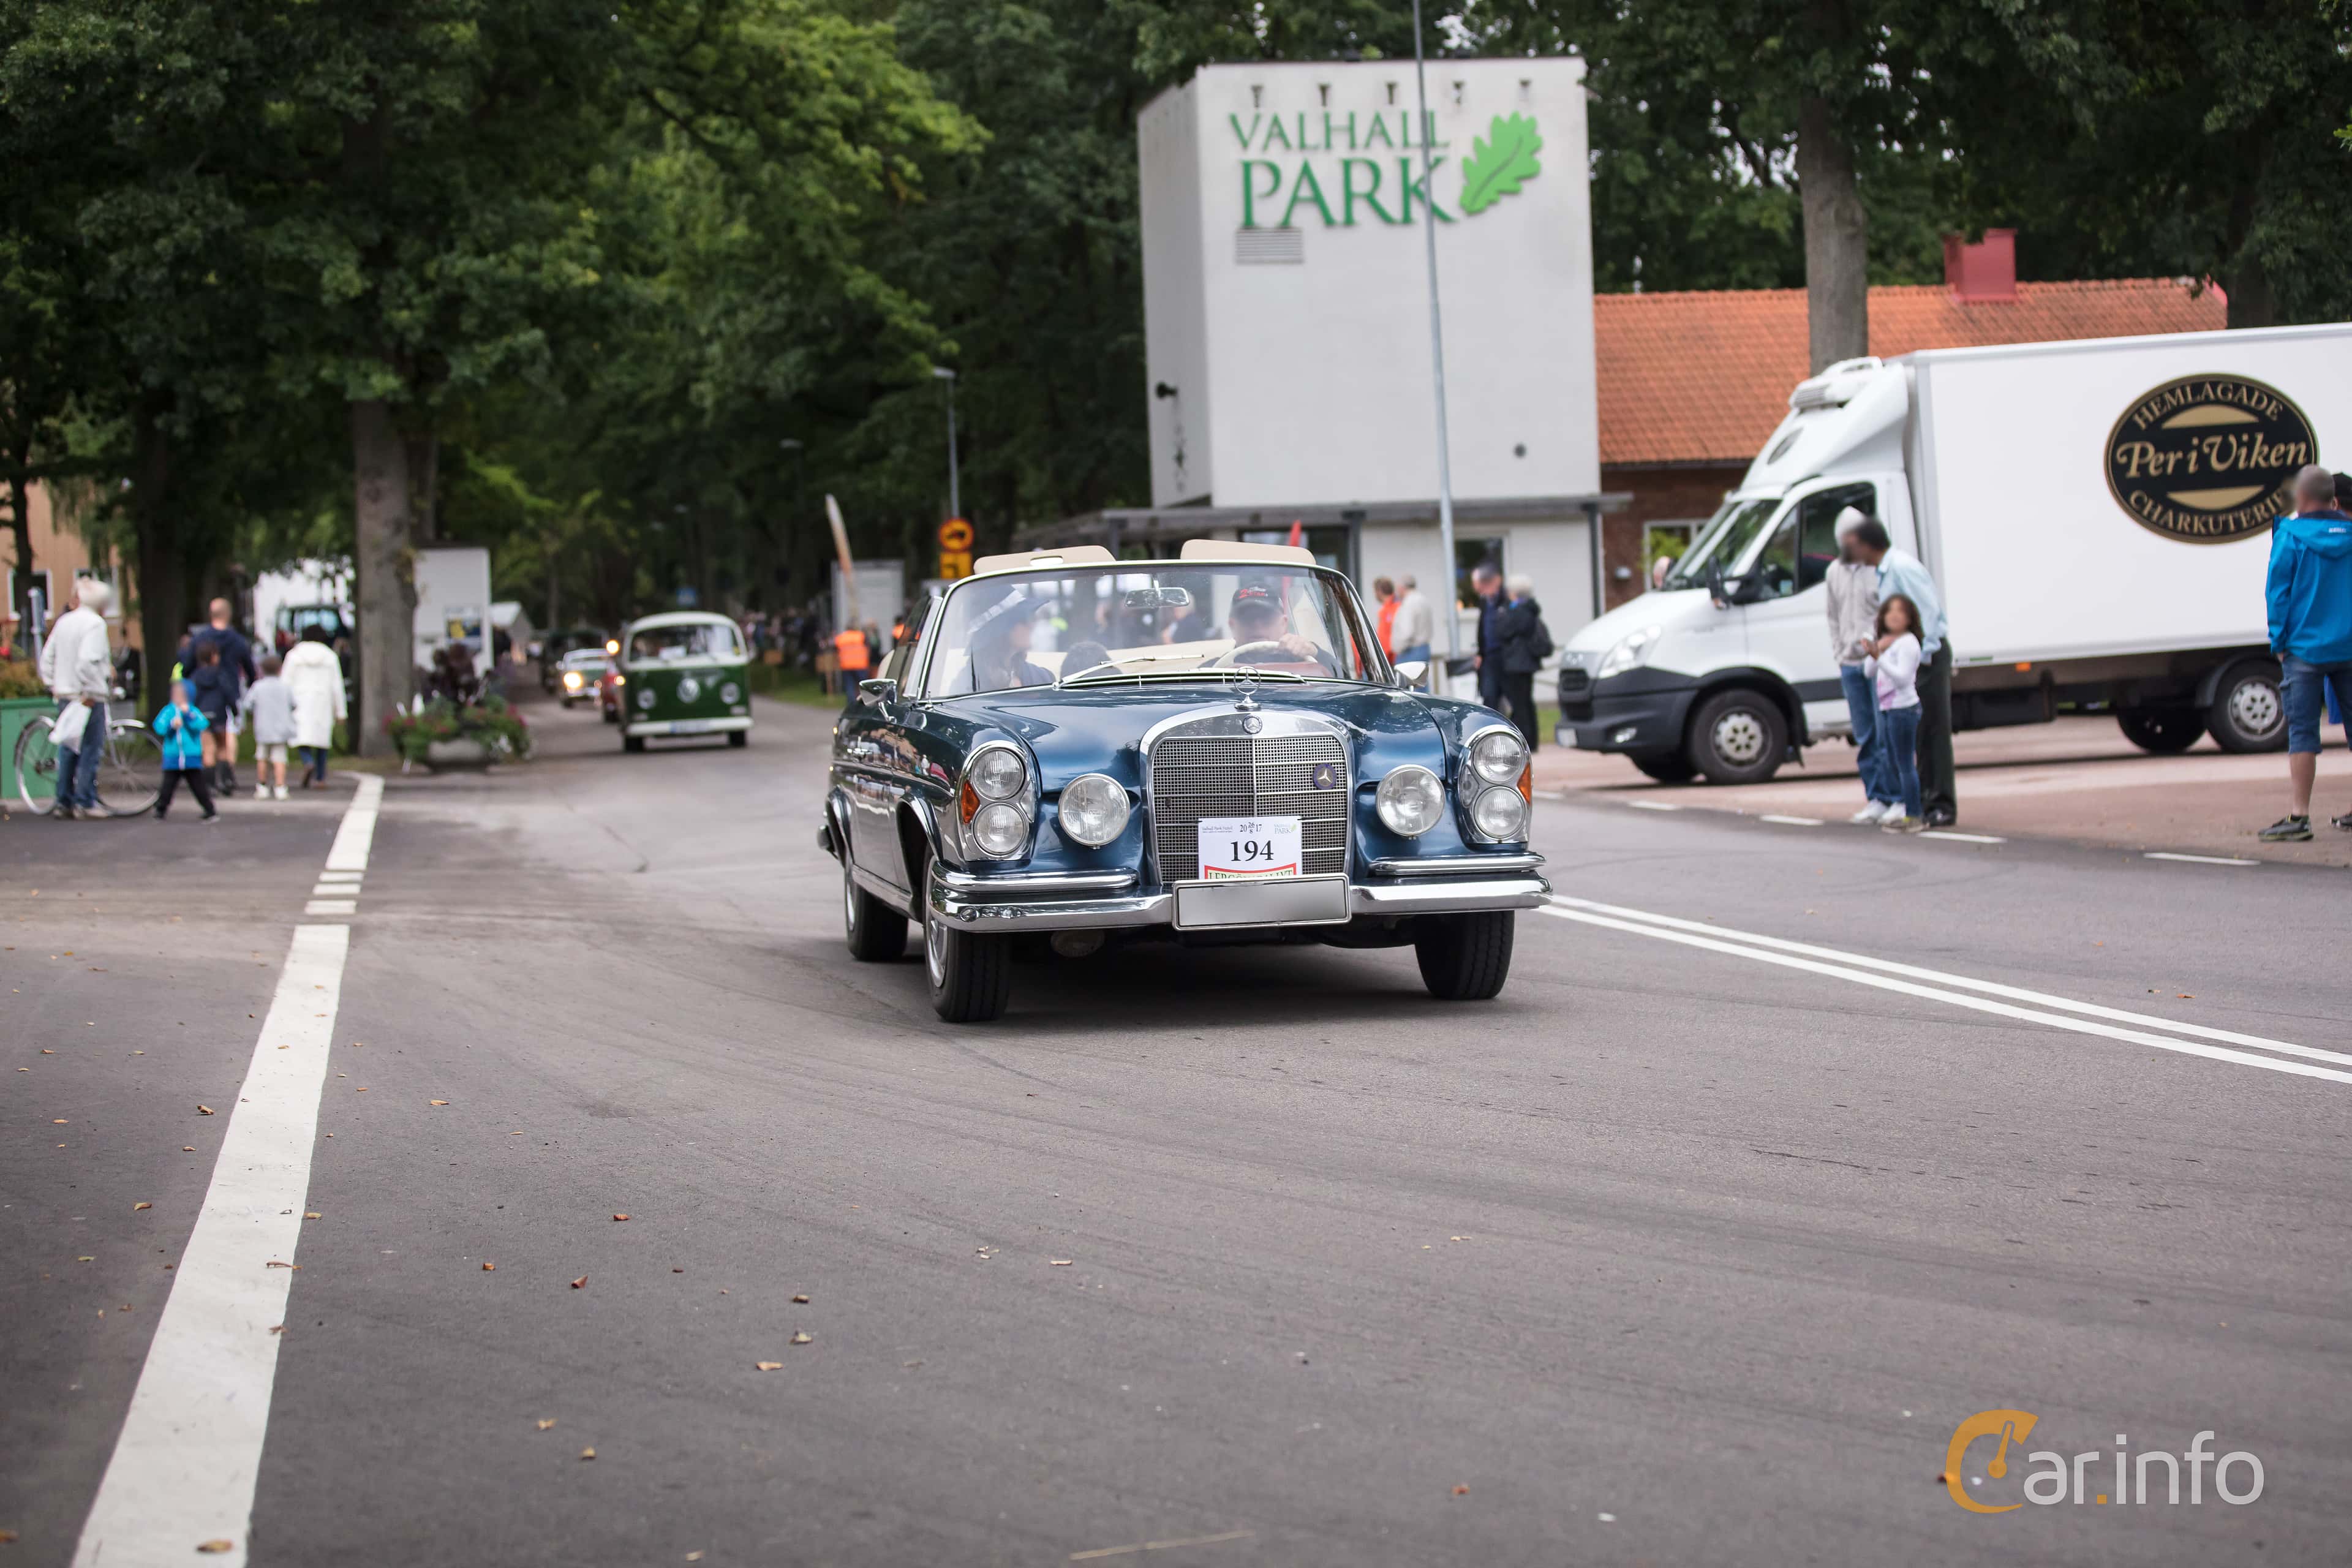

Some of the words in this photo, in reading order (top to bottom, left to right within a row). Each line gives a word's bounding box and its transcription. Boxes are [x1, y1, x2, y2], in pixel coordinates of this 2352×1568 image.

[1229, 110, 1450, 151] VALHALL
[1240, 156, 1458, 227] PARK
[2133, 381, 2283, 429] HEMLAGADE
[2117, 440, 2182, 478] Per
[2187, 437, 2200, 474] i
[2203, 432, 2307, 472] Viken
[1231, 840, 1274, 862] 194
